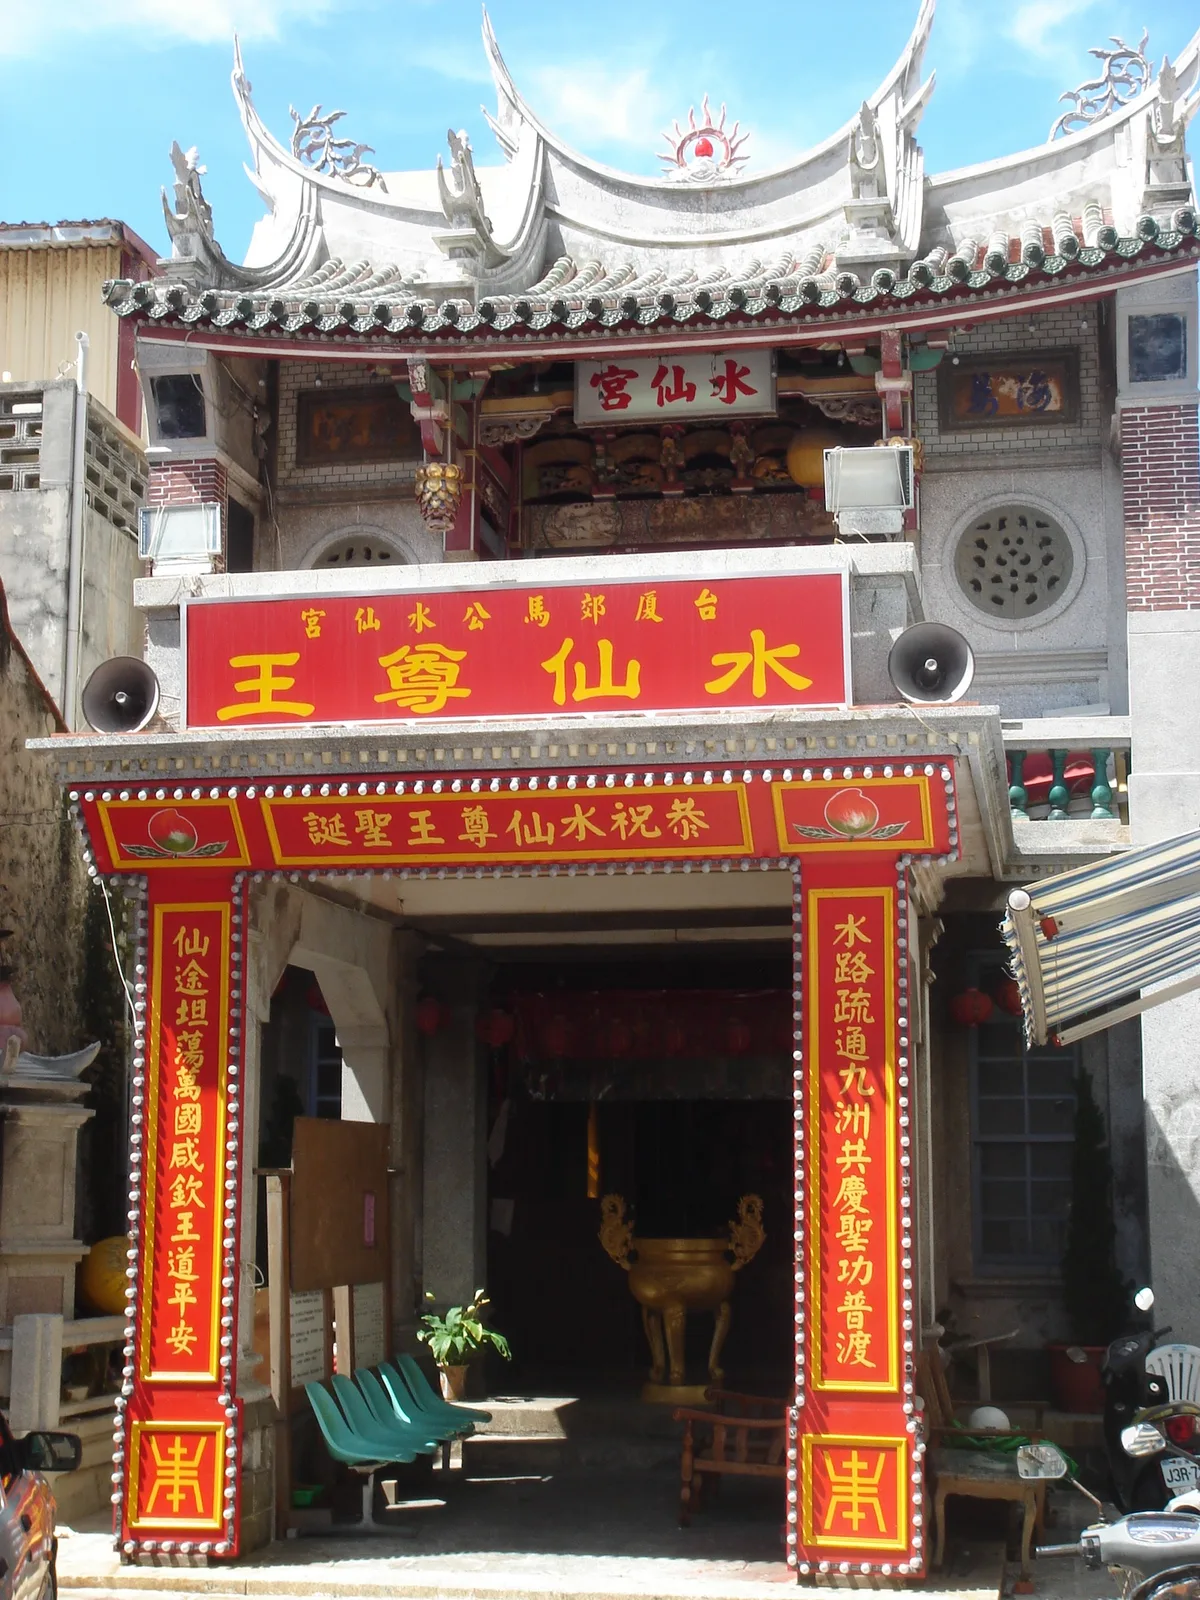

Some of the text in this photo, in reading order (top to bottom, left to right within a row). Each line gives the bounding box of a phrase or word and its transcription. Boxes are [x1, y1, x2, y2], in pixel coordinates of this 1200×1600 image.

[590, 360, 757, 411] 水仙宮
[217, 629, 813, 721] 水仙尊王
[302, 797, 710, 848] 恭祝水仙尊王聖誕
